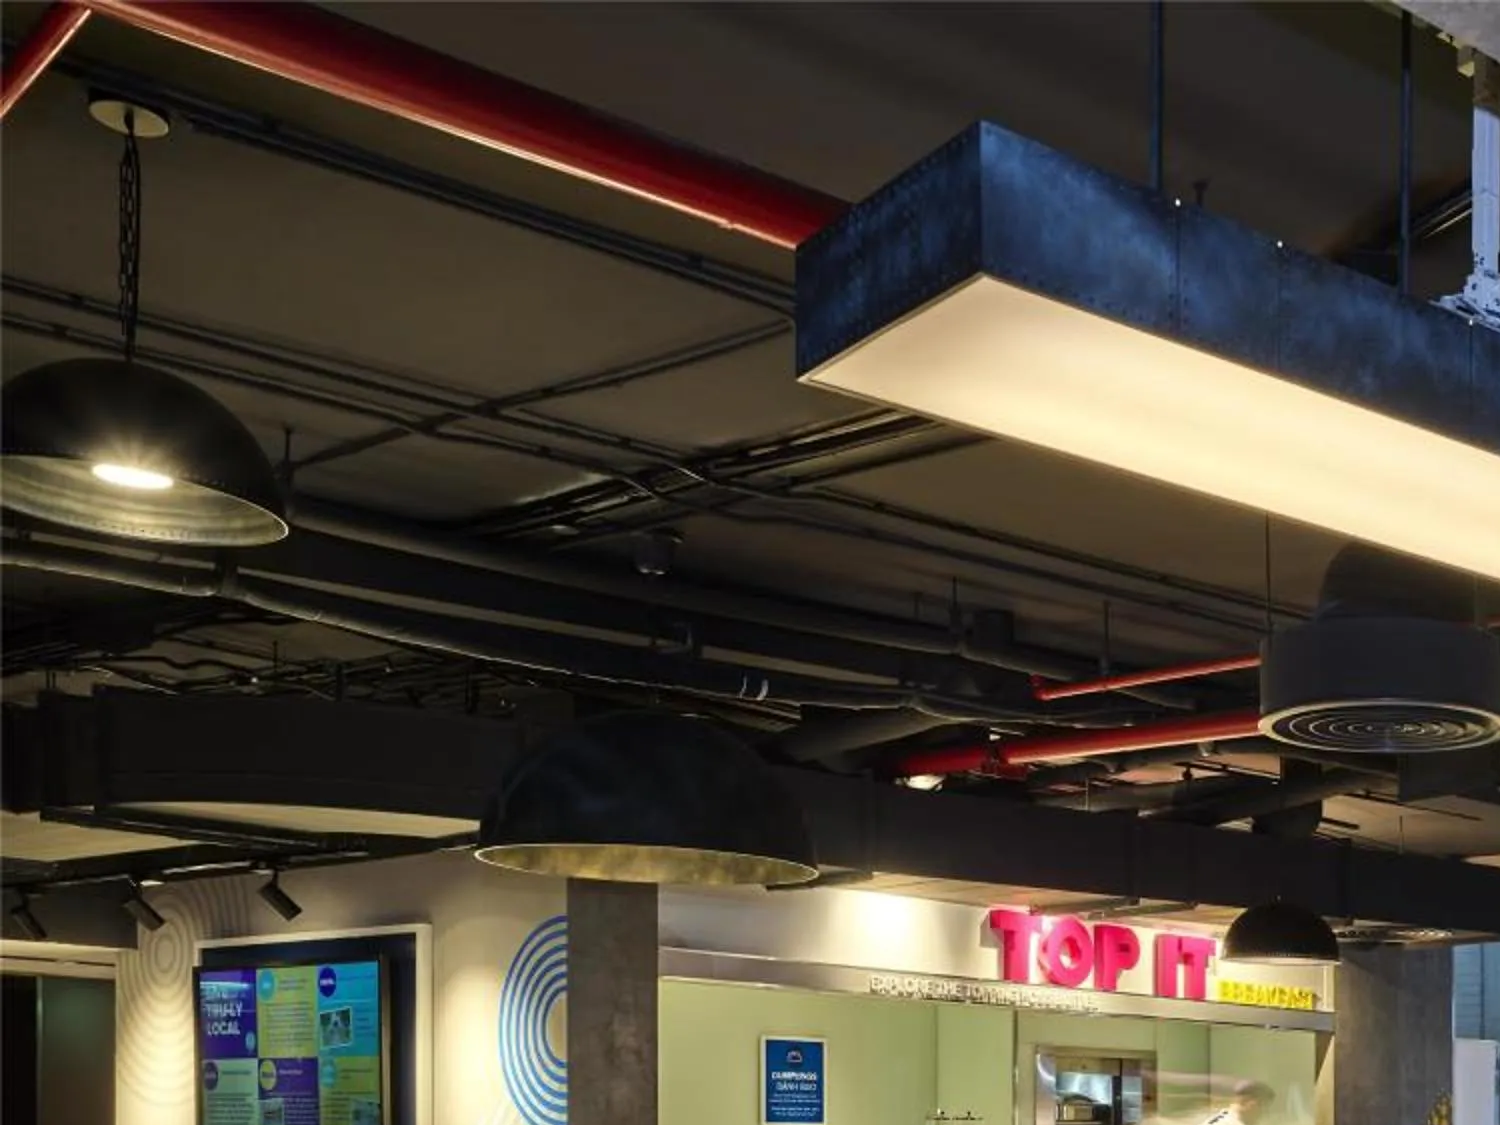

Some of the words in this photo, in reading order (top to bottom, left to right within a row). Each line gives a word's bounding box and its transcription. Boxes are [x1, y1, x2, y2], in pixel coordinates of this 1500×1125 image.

[988, 909, 1141, 992] TOP
[1154, 933, 1216, 1001] IT
[207, 1019, 240, 1036] LOCAL
